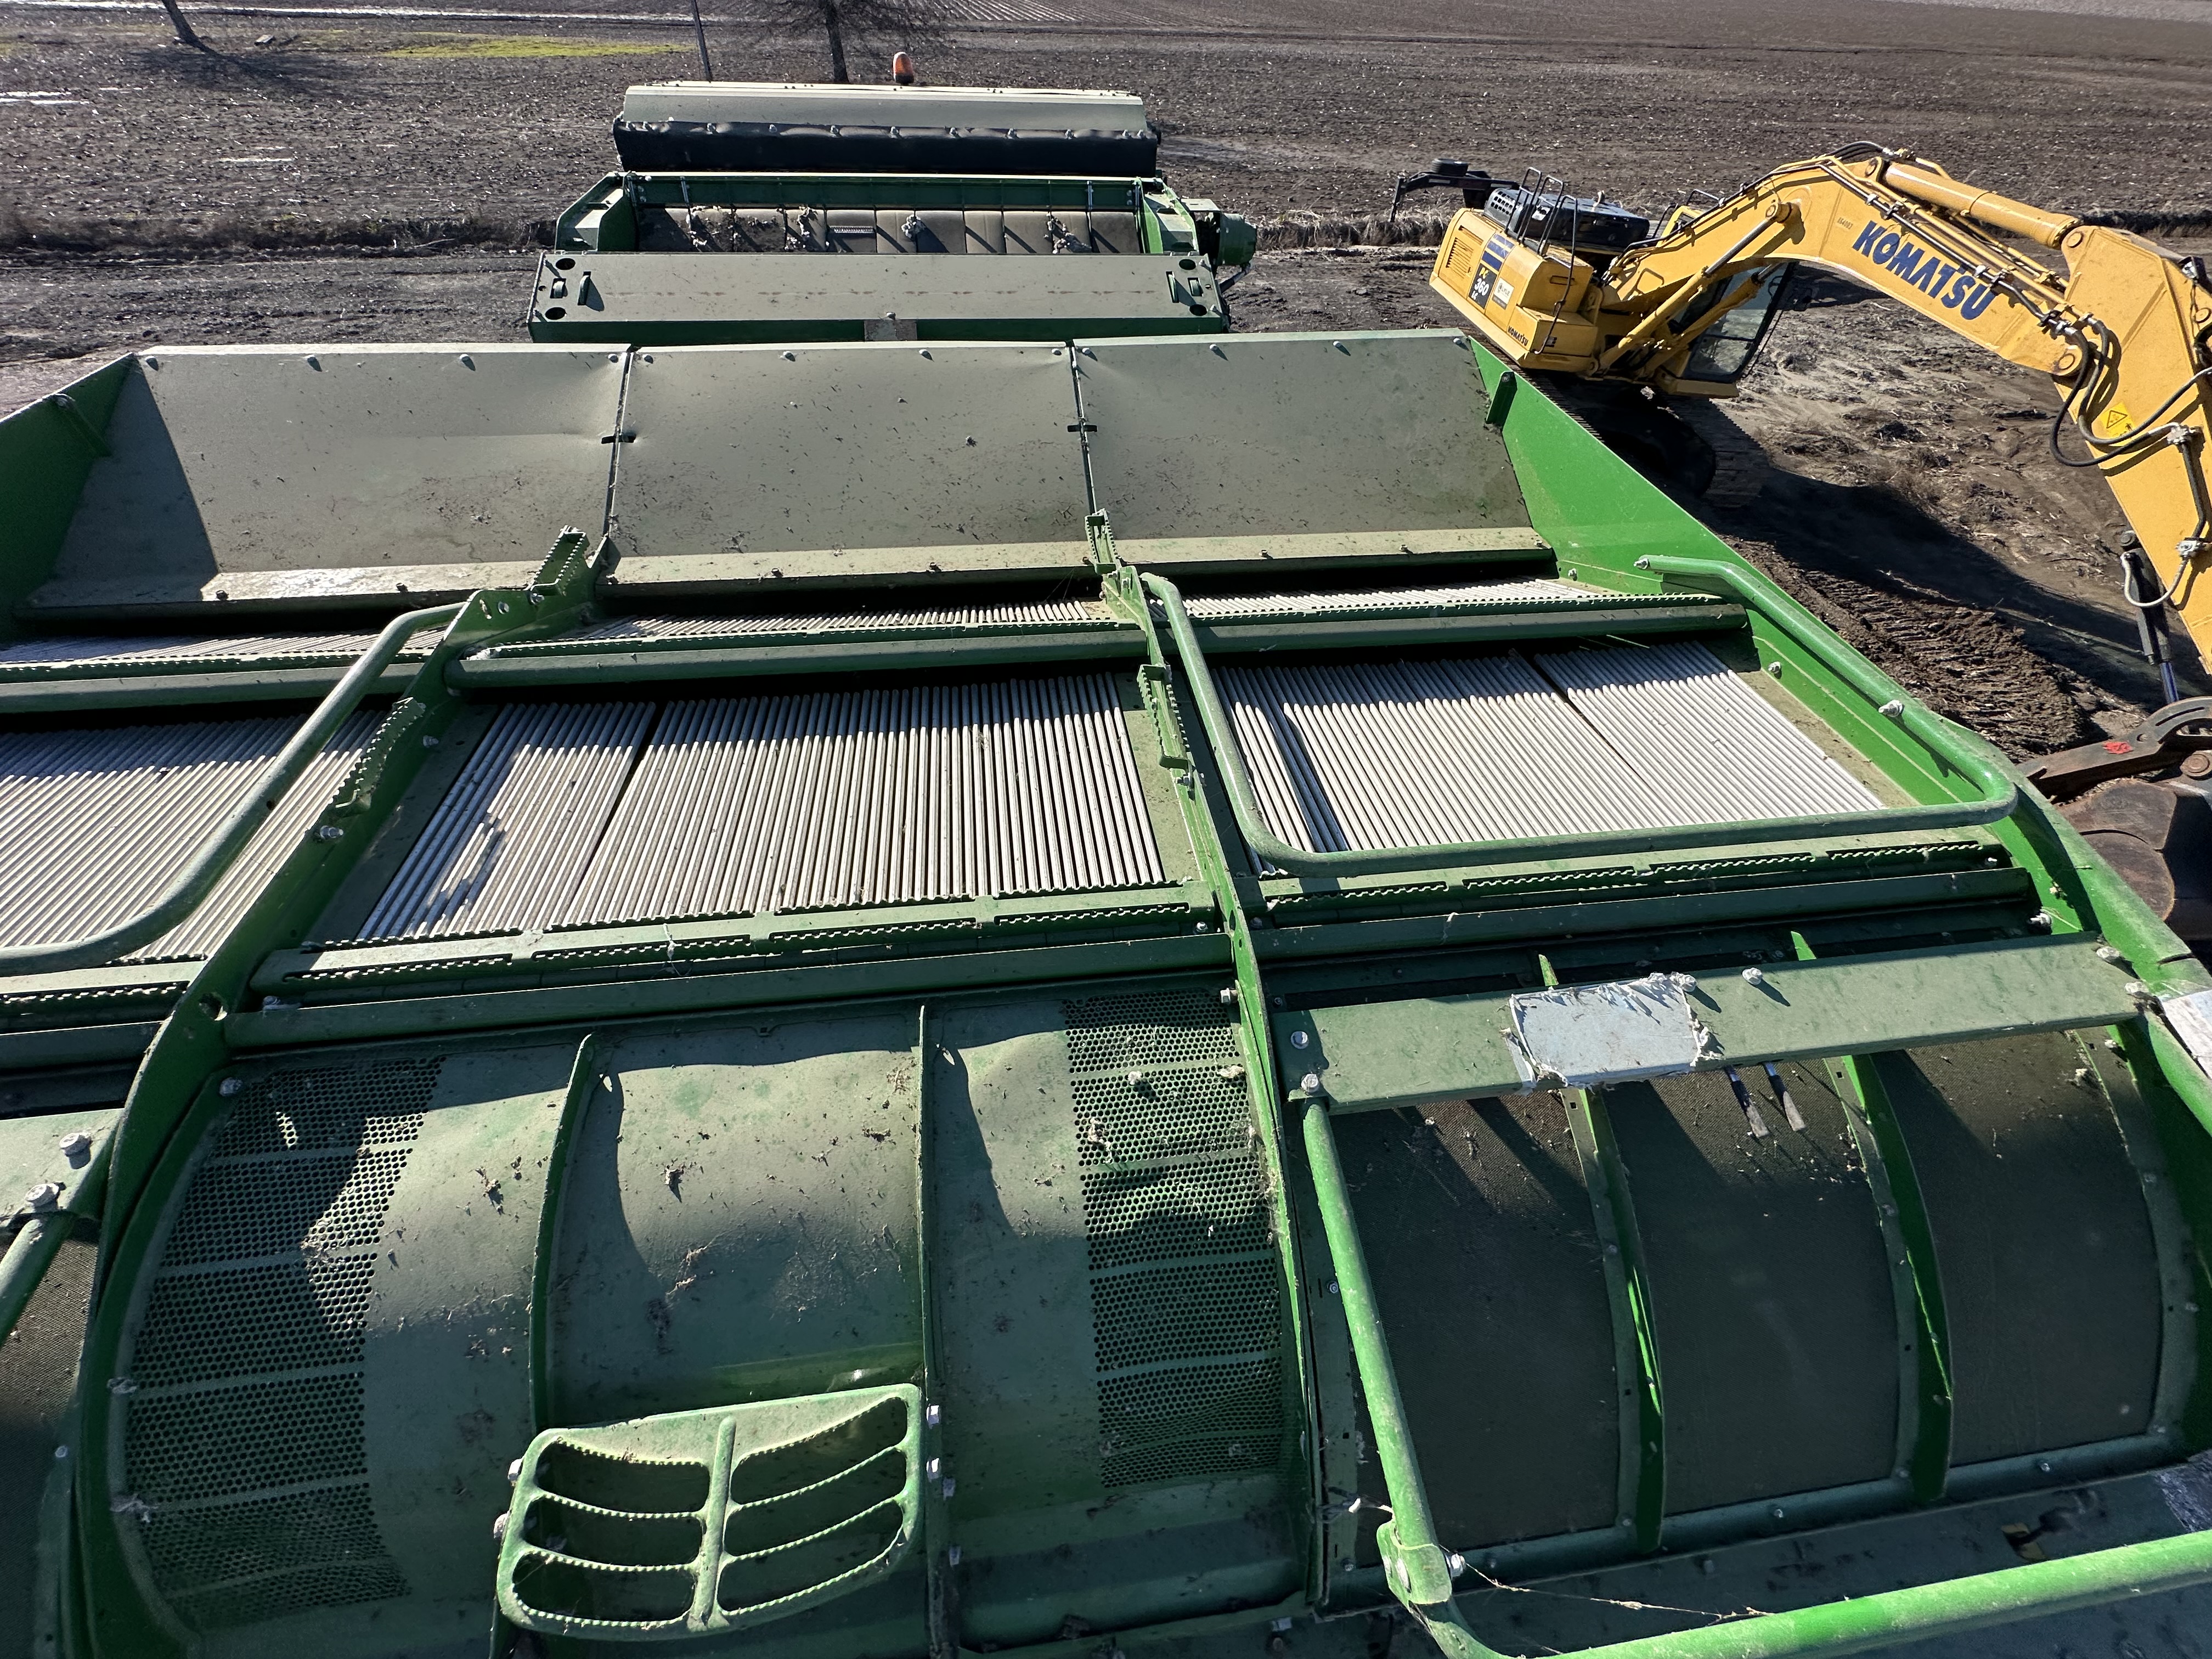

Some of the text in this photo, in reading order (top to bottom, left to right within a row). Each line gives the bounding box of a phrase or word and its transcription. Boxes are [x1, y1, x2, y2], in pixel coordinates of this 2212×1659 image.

[1852, 220, 1997, 320] KOMATSU
[1474, 278, 1489, 296] 360
[1507, 325, 1529, 347] KOMATSU
